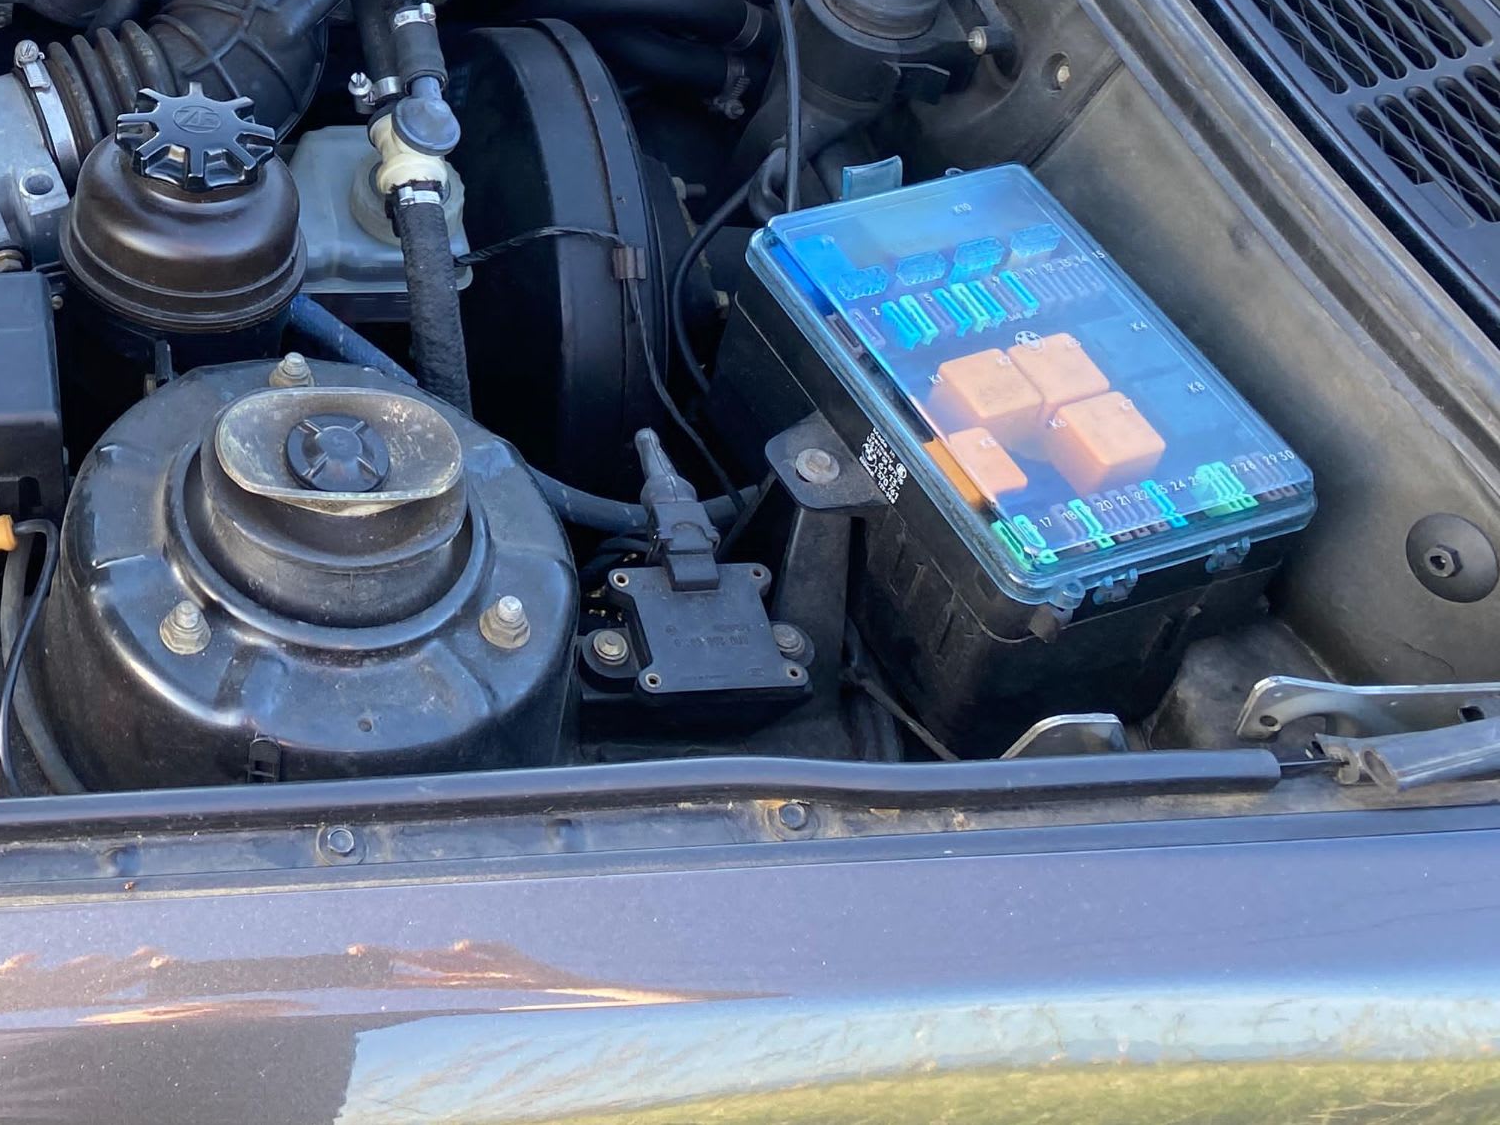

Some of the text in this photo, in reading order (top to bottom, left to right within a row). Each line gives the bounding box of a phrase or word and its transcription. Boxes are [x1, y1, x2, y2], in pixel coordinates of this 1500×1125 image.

[950, 202, 972, 215] K10
[870, 306, 881, 316] 2
[1091, 249, 1106, 261] 15
[1130, 320, 1149, 332] K4
[1039, 515, 1053, 528] 17
[1061, 508, 1078, 521] 18
[1096, 498, 1114, 512] 20
[1116, 494, 1132, 507] 21
[1169, 478, 1187, 492] 24
[1262, 453, 1278, 466] 29
[1278, 449, 1295, 462] 30
